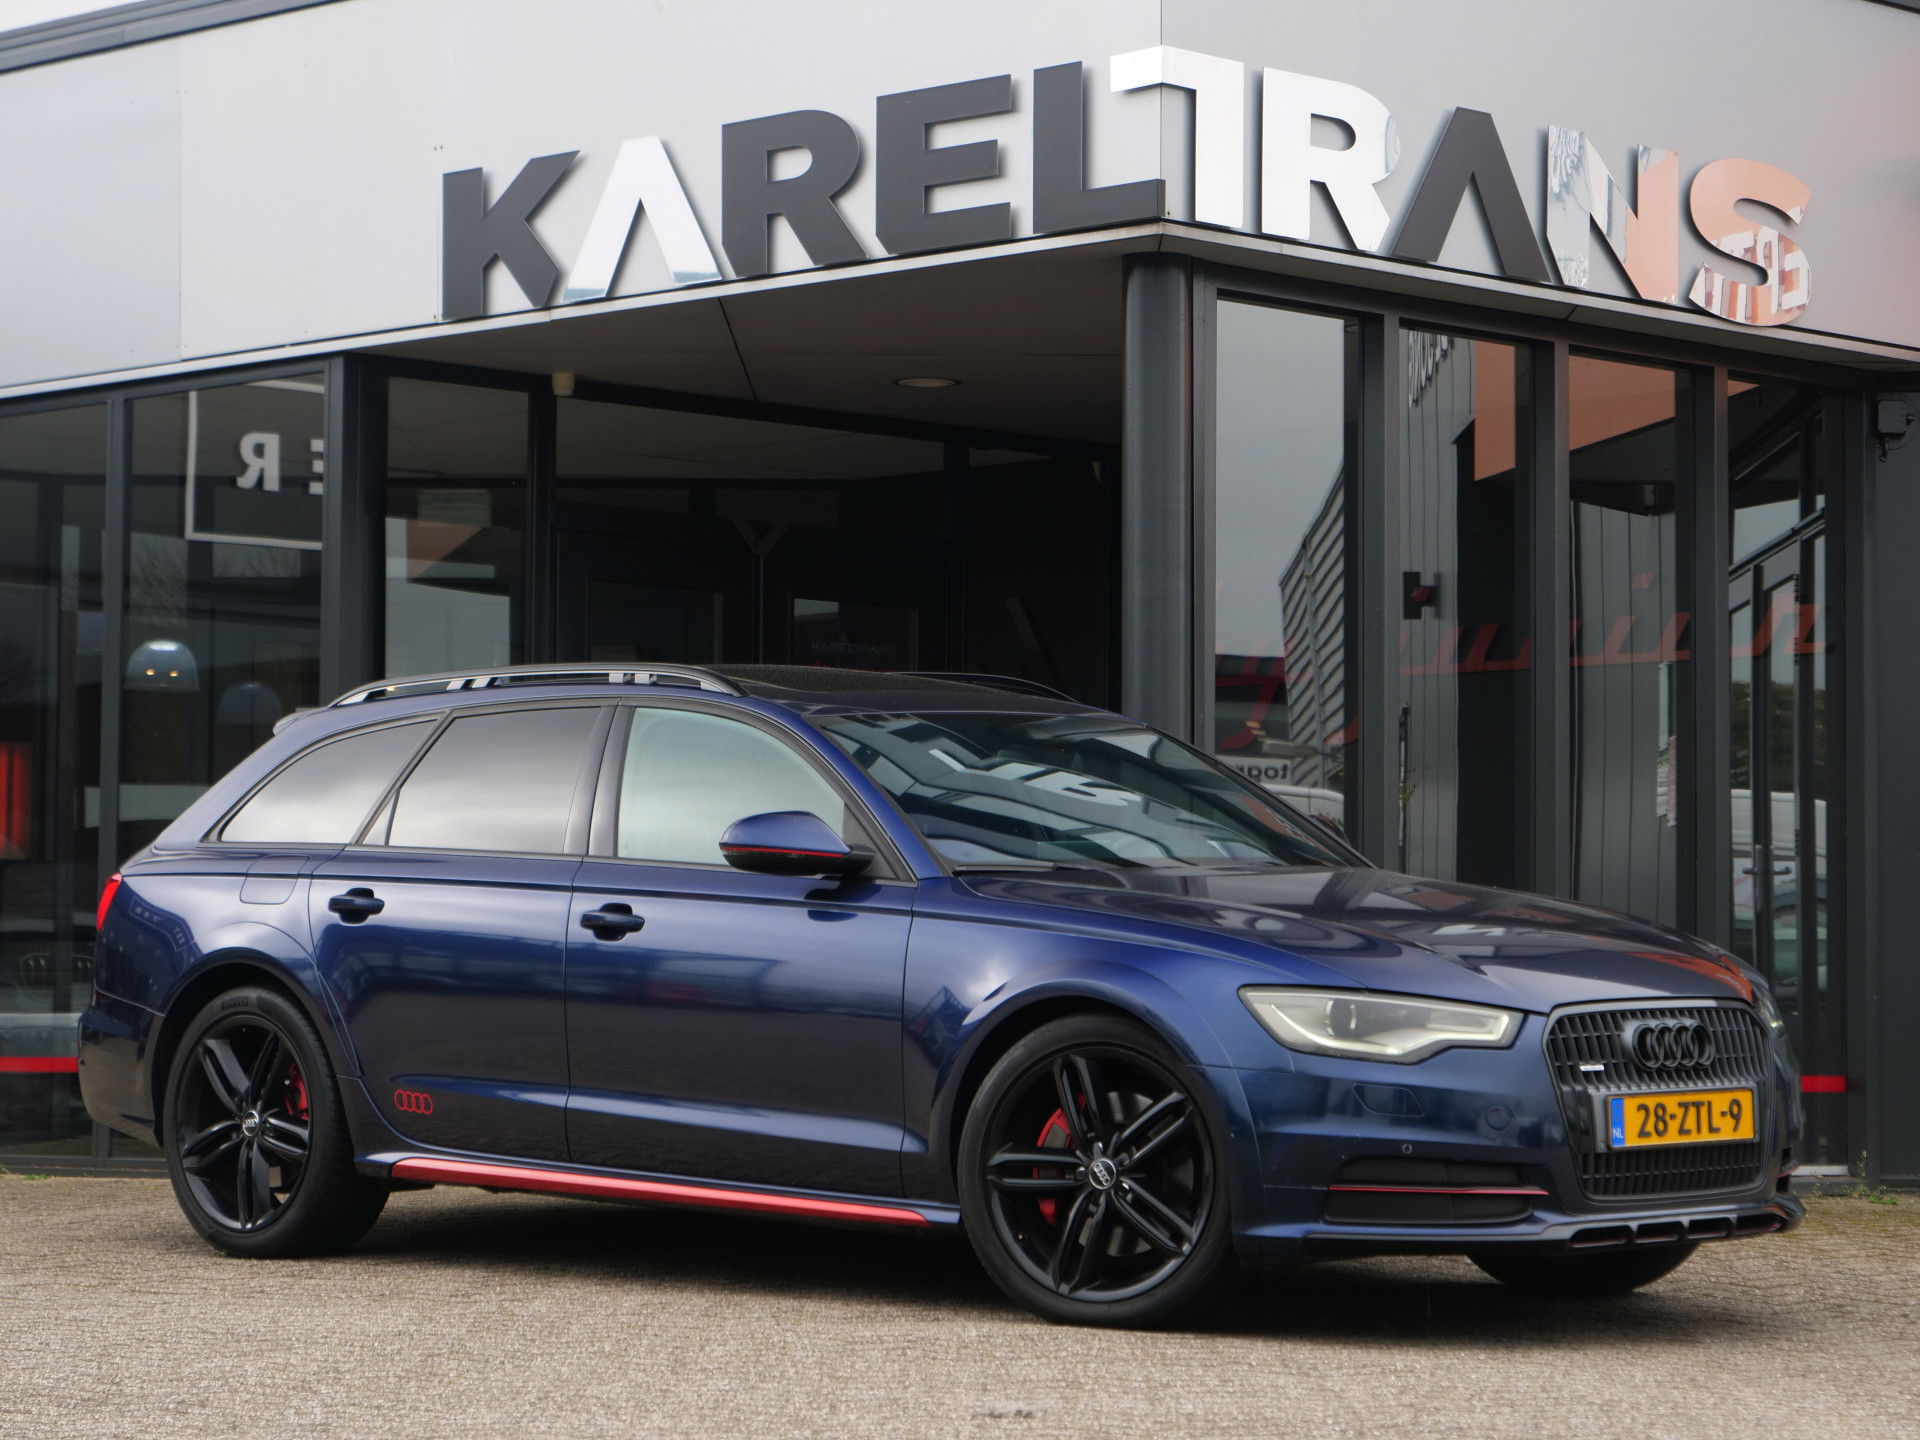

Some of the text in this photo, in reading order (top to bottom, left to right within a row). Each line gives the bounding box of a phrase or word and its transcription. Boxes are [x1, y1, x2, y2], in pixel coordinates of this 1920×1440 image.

[442, 45, 1812, 327] KARELTRANS
[1612, 1127, 1625, 1140] NL
[1636, 1098, 1743, 1138] 28-ZTL-9
